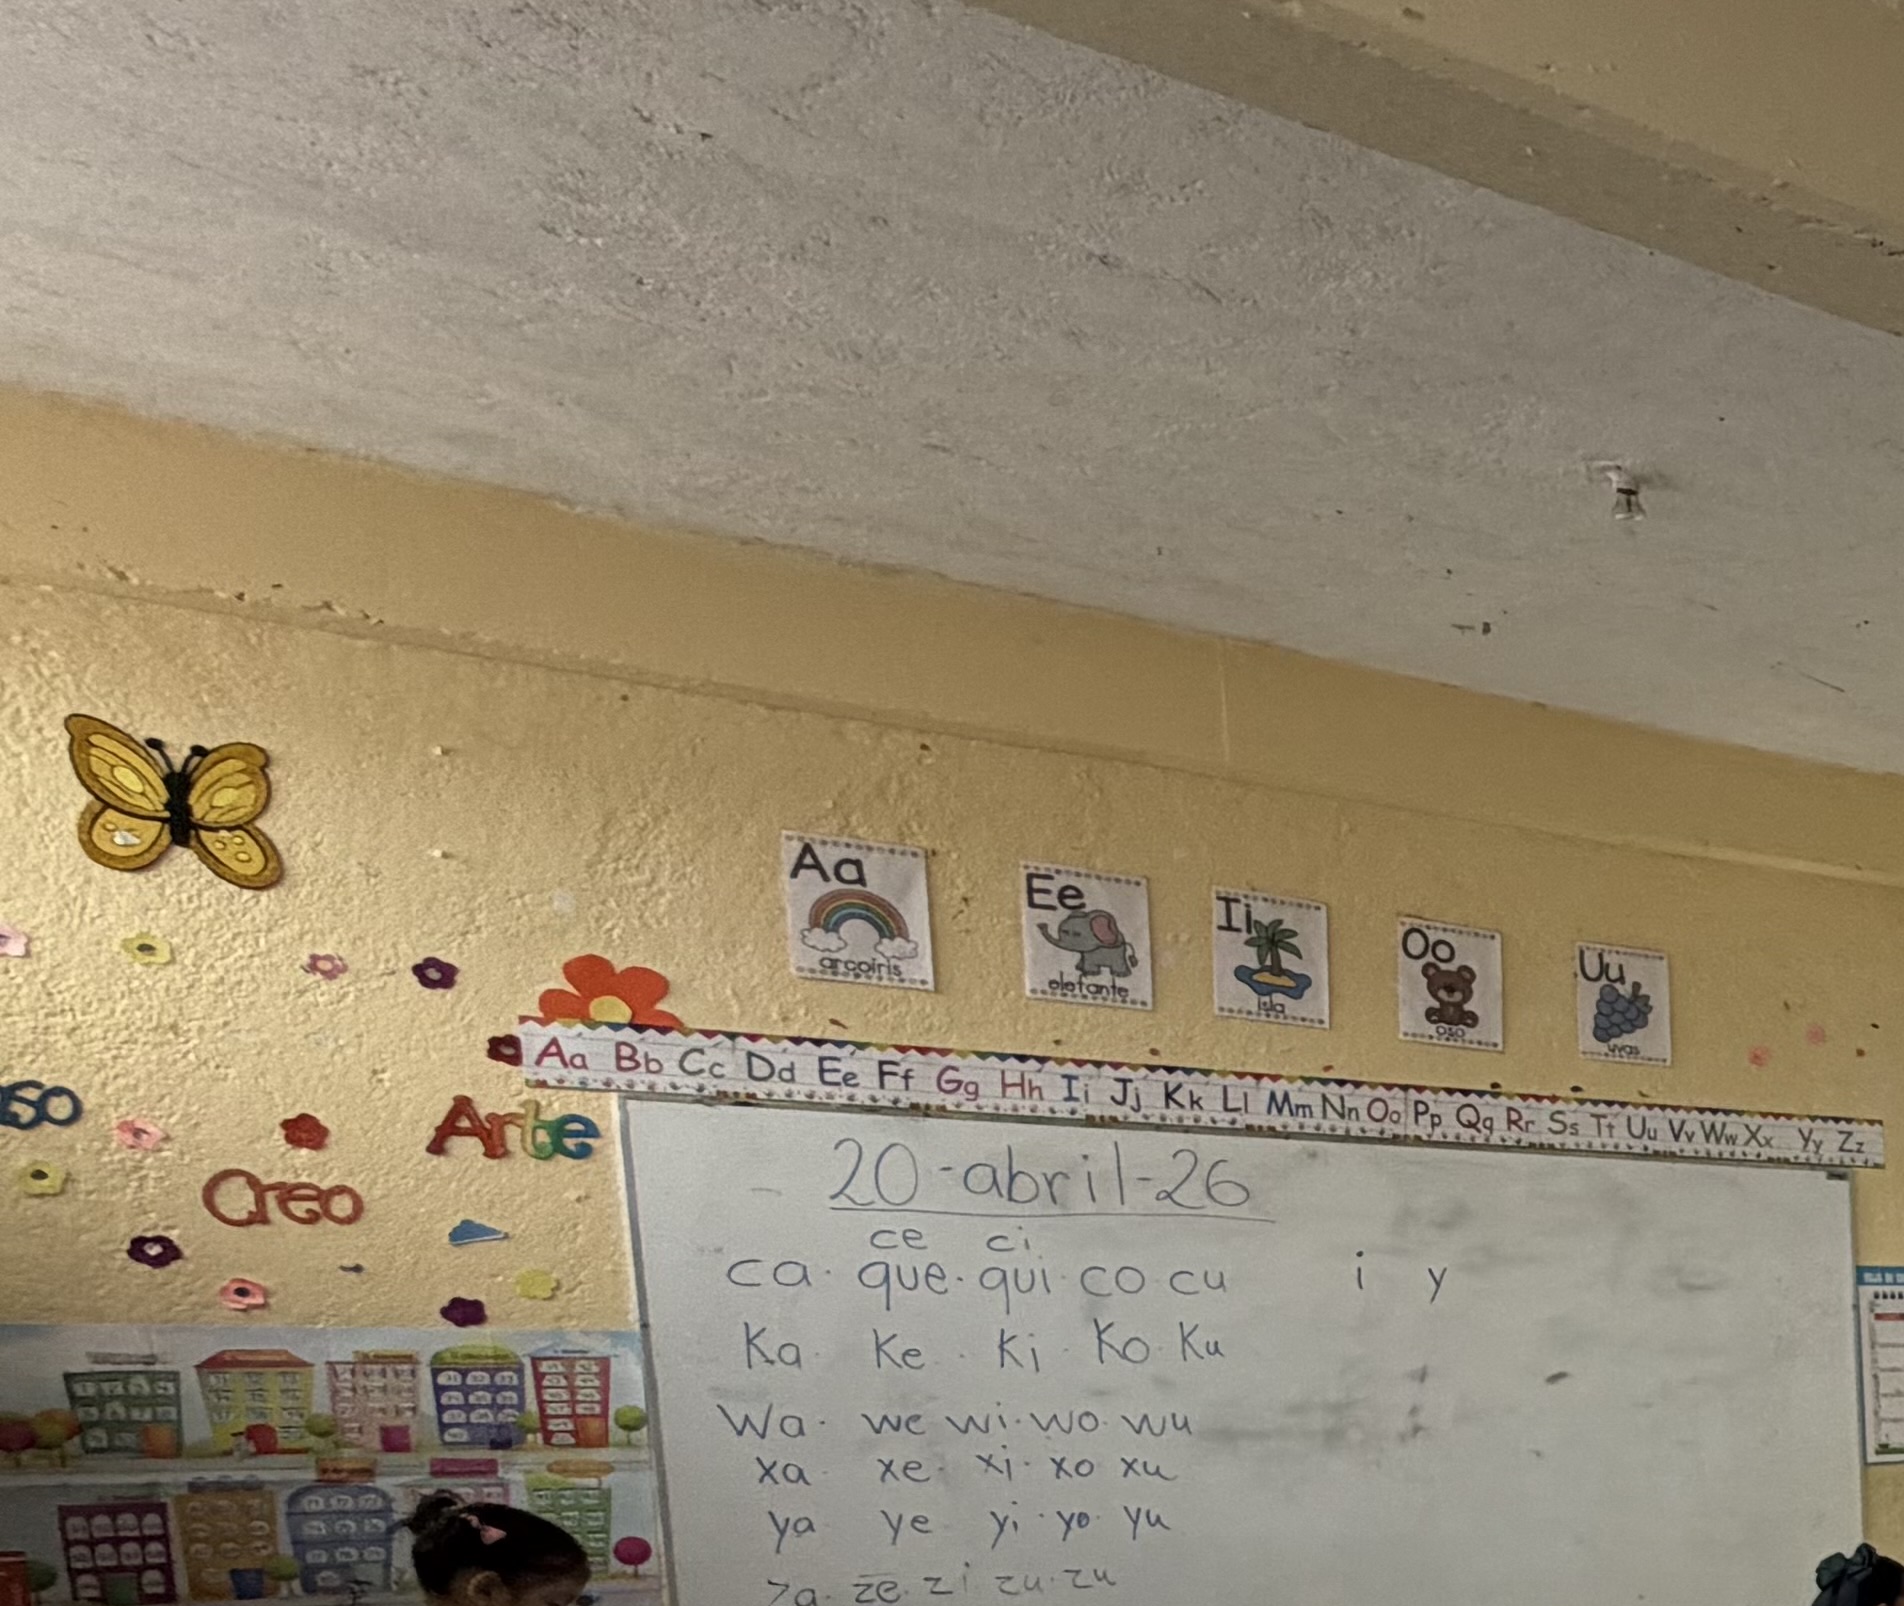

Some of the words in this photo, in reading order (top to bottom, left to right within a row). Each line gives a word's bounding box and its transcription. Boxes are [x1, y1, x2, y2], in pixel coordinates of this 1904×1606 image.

[790, 842, 867, 887] Aa
[1025, 872, 1086, 911] Ee
[1401, 927, 1456, 964] Oo
[819, 953, 903, 978] arcoiris
[1579, 947, 1627, 985] Uu
[1048, 975, 1130, 999] elefante
[1607, 1040, 1641, 1057] uvas
[534, 1037, 589, 1072] Aa
[614, 1042, 665, 1076] Bb
[678, 1046, 727, 1081] Cc
[746, 1052, 797, 1084] Dd
[818, 1056, 860, 1089] Ee
[878, 1062, 915, 1092] Ff
[936, 1065, 980, 1101] Gg
[1001, 1071, 1043, 1101] Hh
[1110, 1078, 1142, 1112] Jj
[1164, 1082, 1204, 1112] Kk
[1266, 1090, 1313, 1119] Mm
[1321, 1093, 1360, 1123] Nn
[1367, 1097, 1401, 1124] Oo
[1413, 1101, 1442, 1130] Pp
[1456, 1103, 1494, 1135] Qq
[1506, 1107, 1536, 1134] Rr
[1548, 1112, 1580, 1137] Ss
[1590, 1113, 1616, 1139] Tt
[1626, 1115, 1658, 1141] Uu
[1668, 1119, 1696, 1144] Vv
[1701, 1121, 1738, 1147] Ww
[1743, 1123, 1774, 1149] Xx
[1797, 1127, 1824, 1154] Yy
[1837, 1129, 1866, 1155] Zz
[426, 1095, 600, 1160] Arte
[202, 1168, 364, 1227] Creo
[869, 1226, 927, 1251] ce
[985, 1225, 1031, 1252] ci
[726, 1258, 812, 1288] ca
[856, 1260, 949, 1311] que
[978, 1256, 1051, 1315] qui
[1080, 1265, 1145, 1296] co
[1169, 1265, 1227, 1295] cu
[1355, 1250, 1364, 1290] i
[1427, 1266, 1447, 1304] y
[1121, 1456, 1178, 1481] xu
[769, 1510, 816, 1553] ya
[881, 1509, 931, 1545] ye
[989, 1501, 1019, 1549] yi
[1056, 1509, 1090, 1541] yo
[1123, 1504, 1171, 1541] yu
